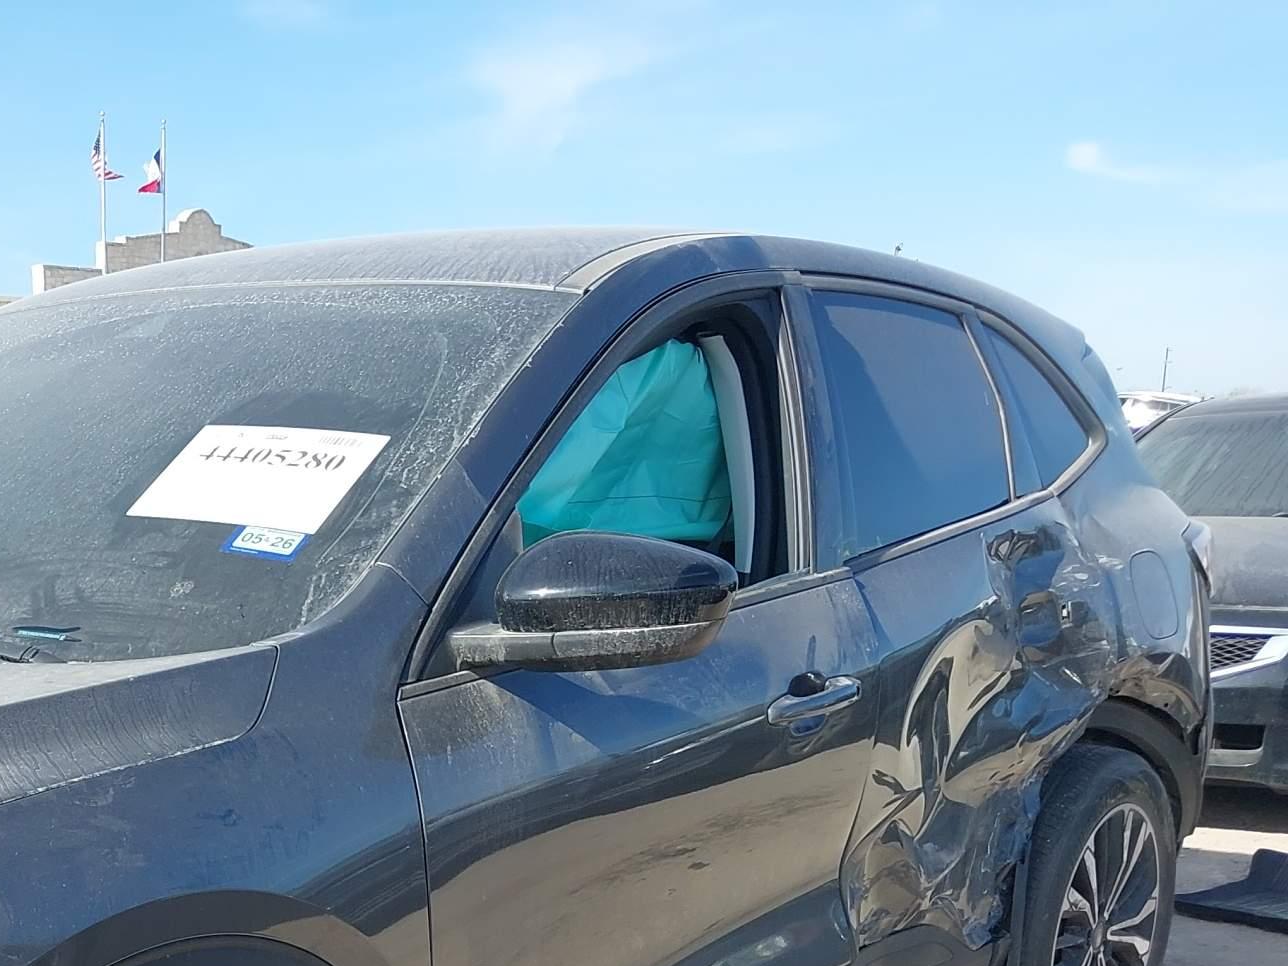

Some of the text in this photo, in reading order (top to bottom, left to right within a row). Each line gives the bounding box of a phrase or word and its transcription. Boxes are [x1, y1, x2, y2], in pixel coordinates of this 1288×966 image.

[199, 446, 346, 471] 44405280
[241, 532, 295, 549] 05 26
